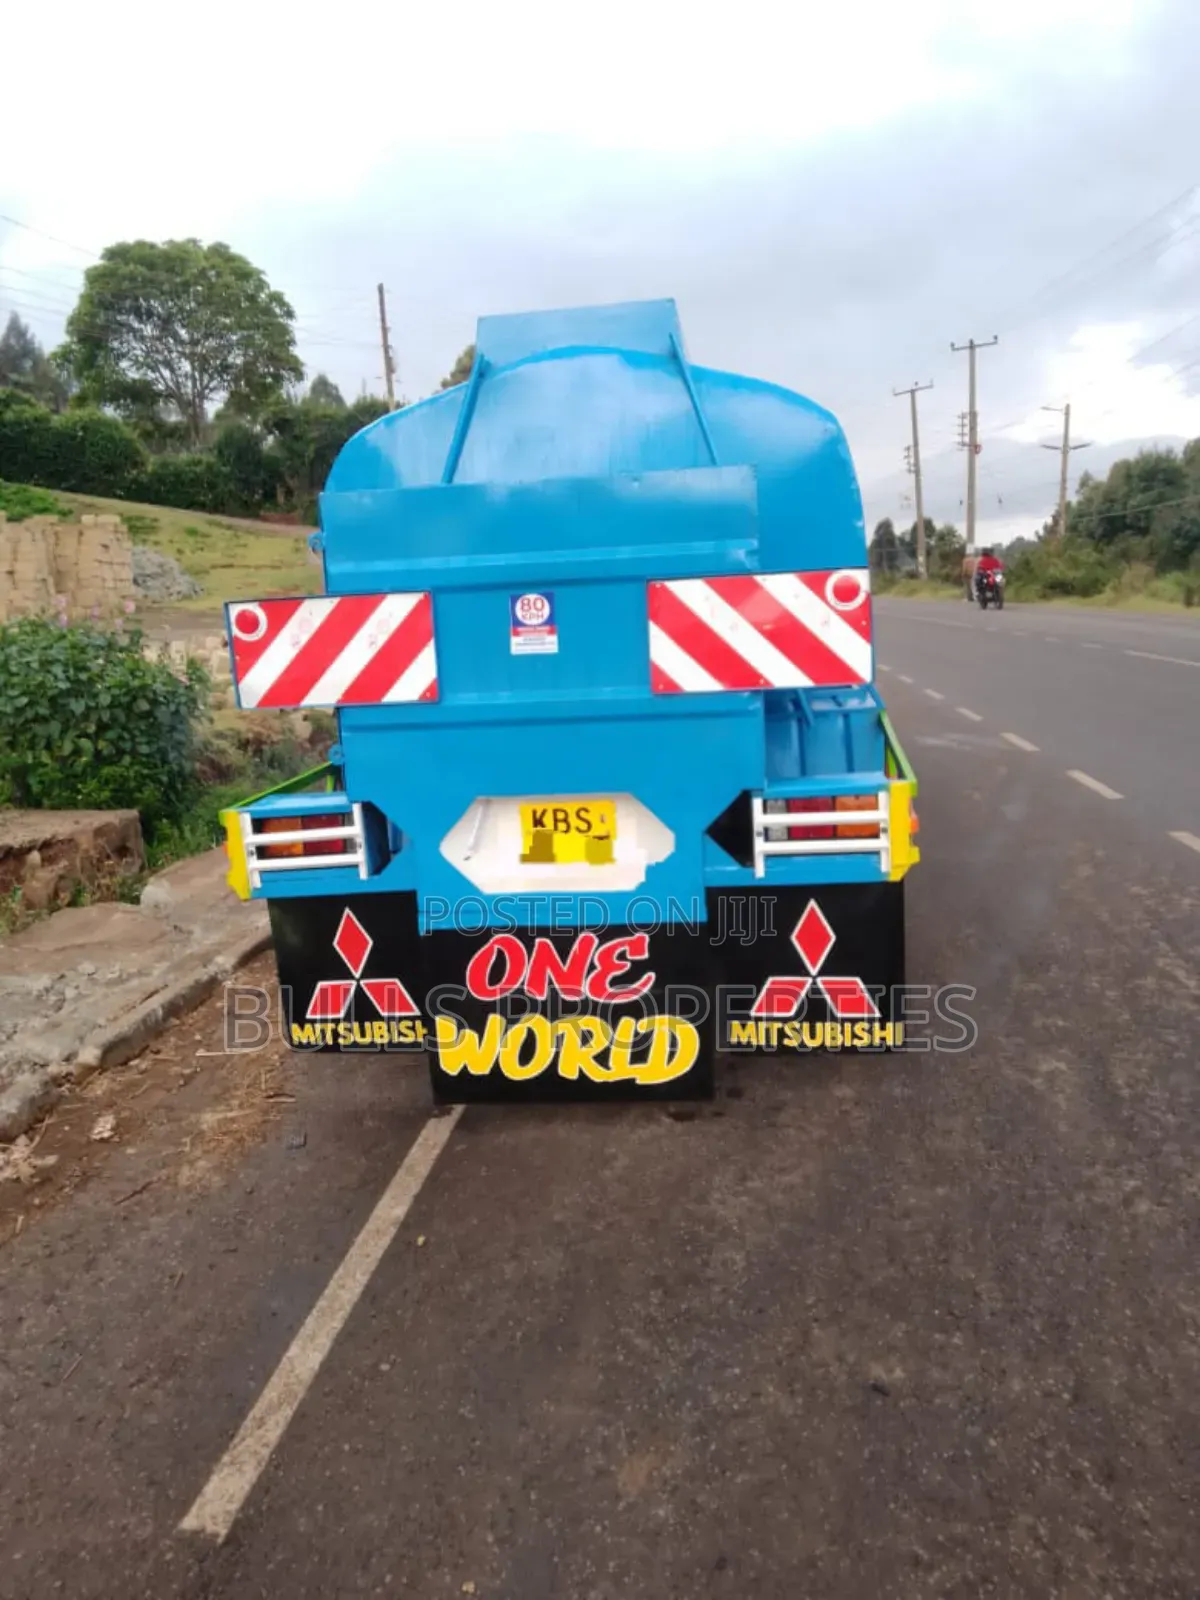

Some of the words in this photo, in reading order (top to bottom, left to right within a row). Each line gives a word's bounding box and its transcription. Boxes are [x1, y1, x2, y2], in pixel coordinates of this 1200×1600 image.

[521, 597, 545, 612] 80
[466, 933, 656, 1001] ONE
[291, 1020, 428, 1046] MITSUBISH
[730, 1020, 903, 1047] MITSUBISHI
[435, 1013, 700, 1085] WORLD
